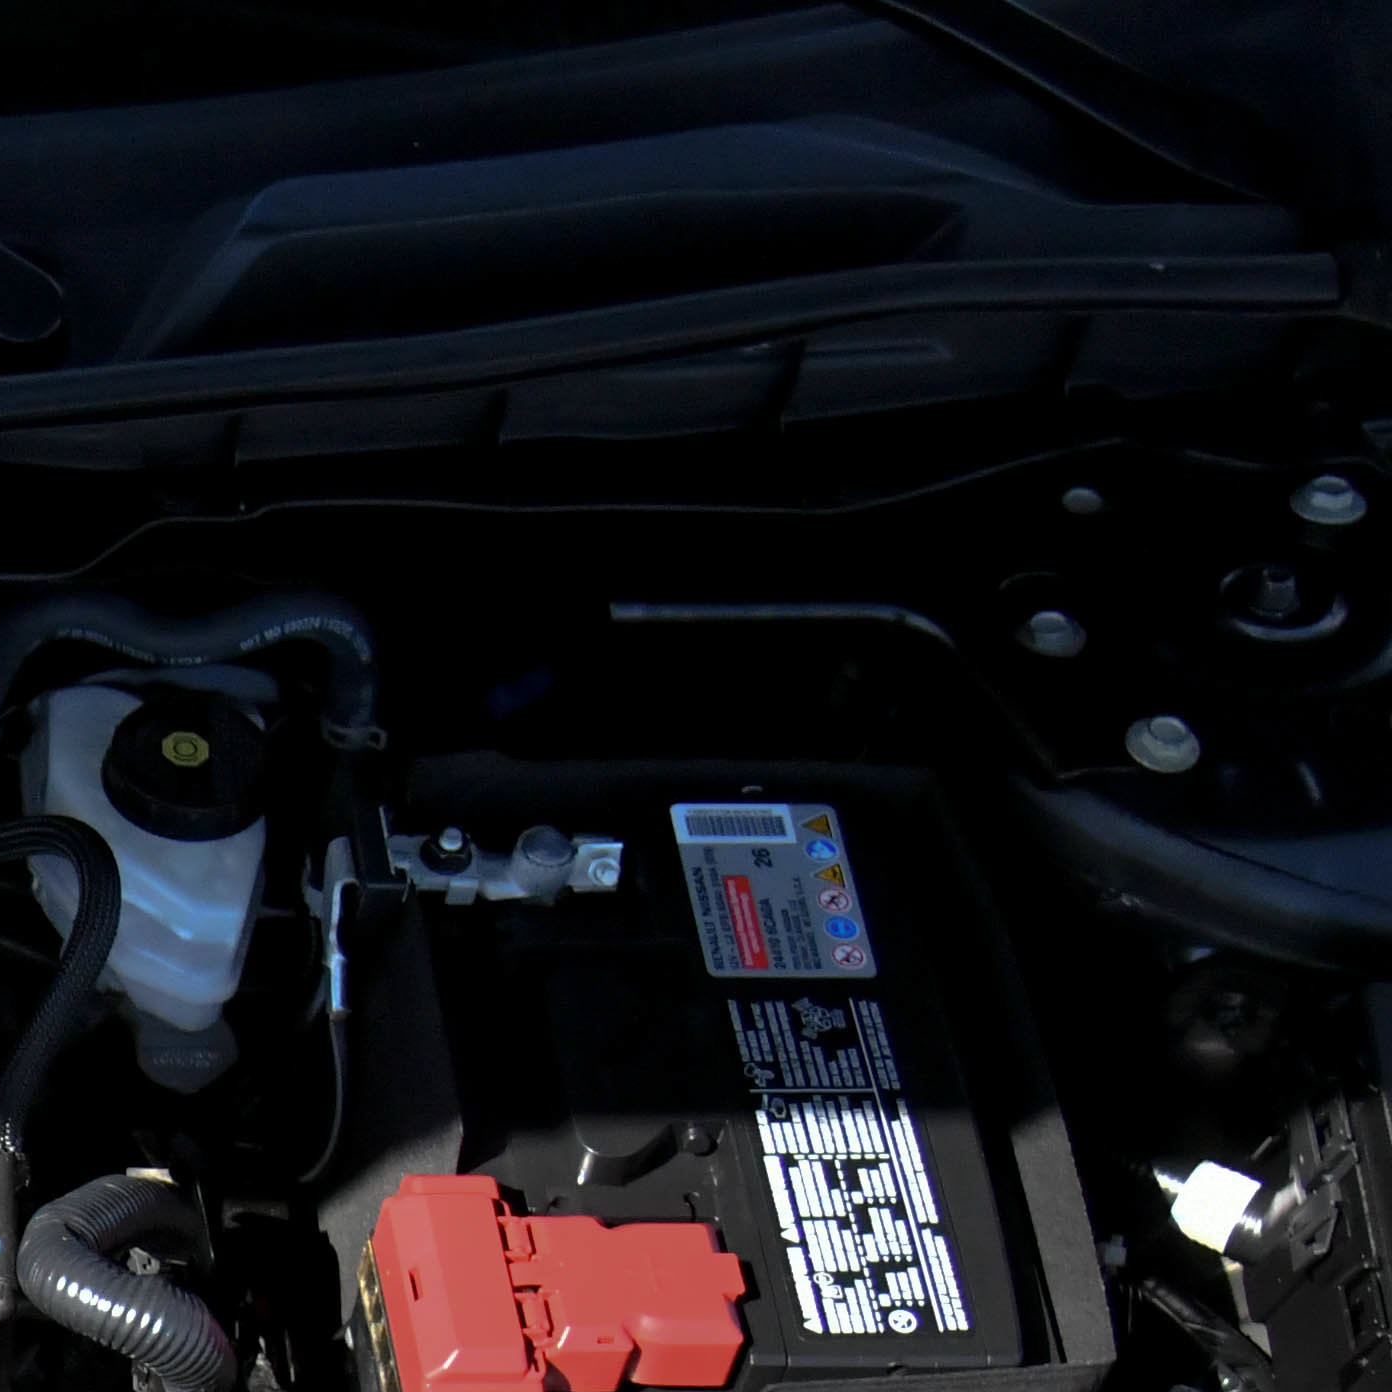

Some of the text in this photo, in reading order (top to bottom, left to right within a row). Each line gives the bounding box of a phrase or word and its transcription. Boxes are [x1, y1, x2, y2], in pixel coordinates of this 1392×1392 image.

[751, 848, 774, 869] 26
[691, 866, 726, 970] RENAULT NISSAN
